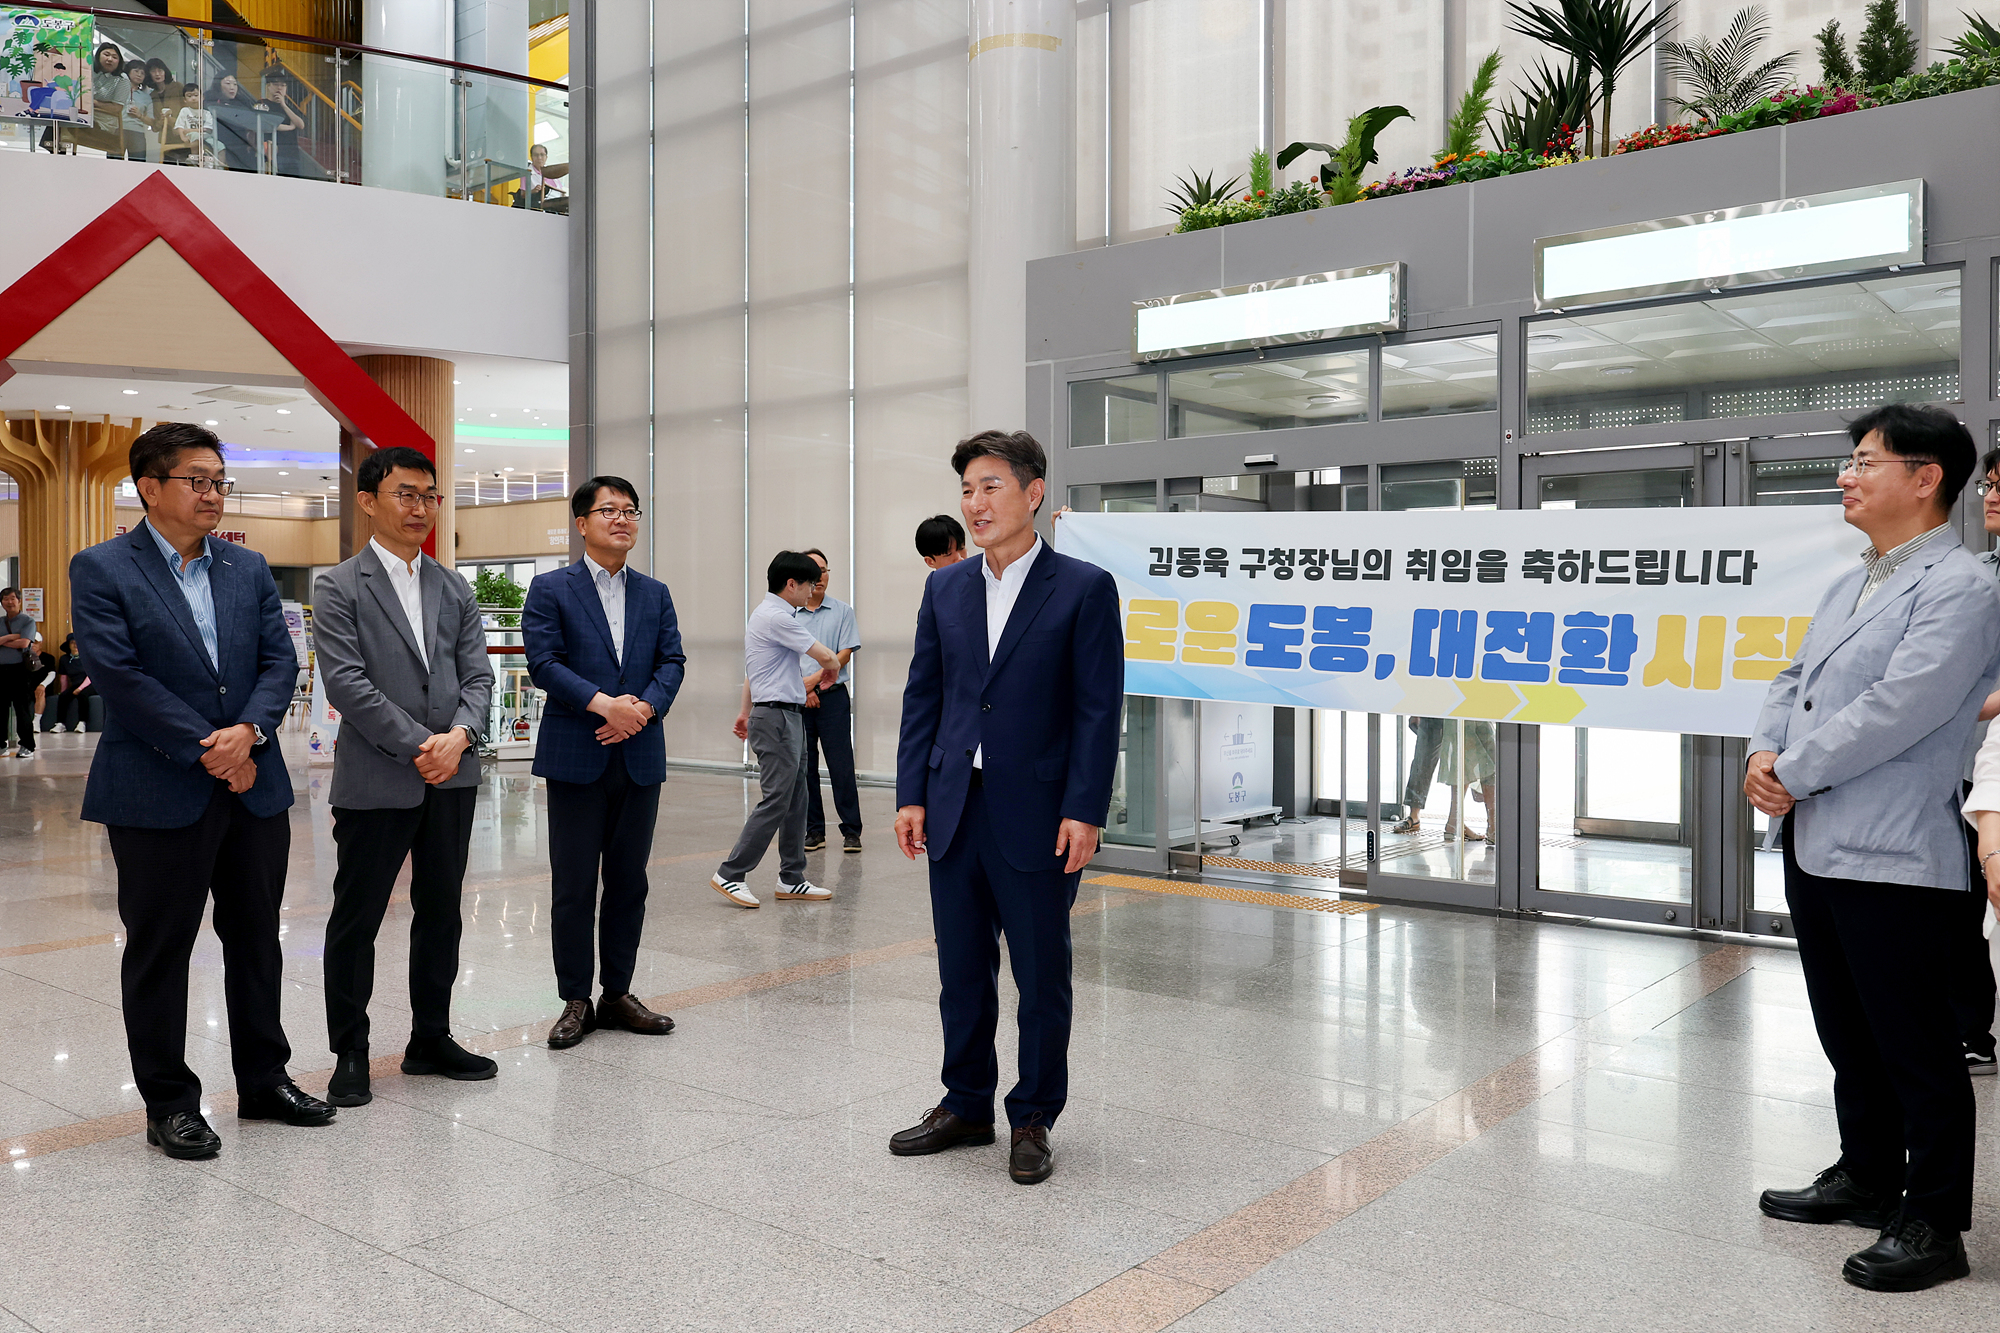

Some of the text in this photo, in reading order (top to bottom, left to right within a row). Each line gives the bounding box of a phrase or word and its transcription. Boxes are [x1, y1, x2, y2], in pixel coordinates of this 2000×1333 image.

[42, 19, 74, 31] 도봉구
[1149, 547, 1759, 586] 김동욱 구청장님의 취임을 축하드립니다
[1119, 598, 1239, 666] 로운
[1245, 603, 1396, 681] 도봉,
[1409, 608, 1639, 687] 대전환
[1228, 790, 1246, 803] 도봉구
